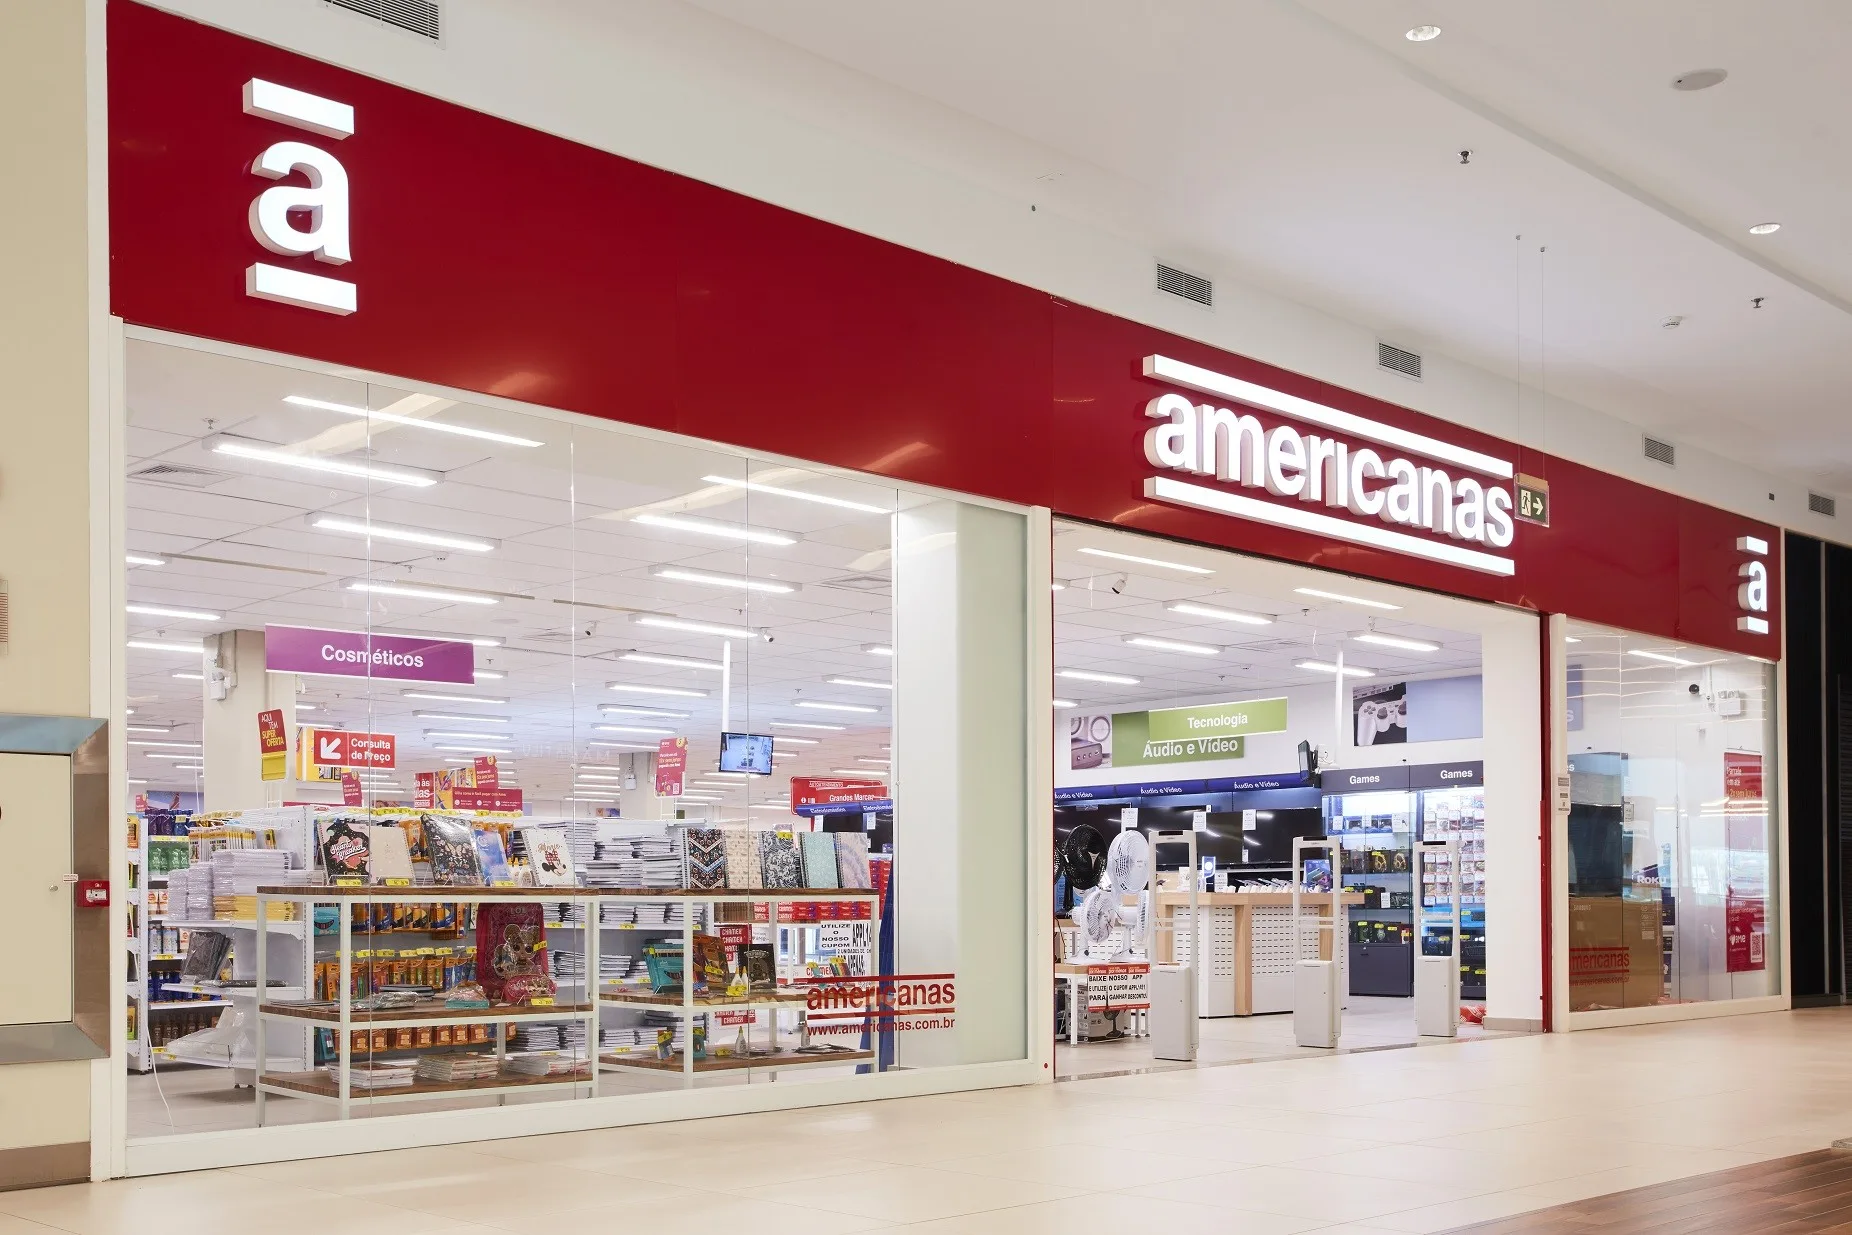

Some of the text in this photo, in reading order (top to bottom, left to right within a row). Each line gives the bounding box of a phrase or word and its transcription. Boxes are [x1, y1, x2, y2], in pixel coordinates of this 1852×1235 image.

[249, 141, 352, 266] a
[1144, 392, 1514, 549] americanas
[1738, 561, 1768, 612] a
[321, 644, 424, 668] Cosméticos
[1187, 713, 1249, 729] Tecnologia
[262, 730, 276, 740] SUPER
[266, 737, 285, 748] OFERTA
[351, 738, 391, 750] Consulta
[1143, 738, 1239, 758] Áudio e Vídeo
[351, 751, 391, 764] de Preço
[1349, 774, 1380, 785] Games
[1440, 769, 1474, 780] Games
[1140, 787, 1158, 795] Áudio
[1234, 781, 1254, 789] Áudio
[829, 794, 853, 802] Grandes
[1077, 791, 1094, 799] Vídeo
[1569, 952, 1630, 971] mericanas
[807, 983, 955, 1010] americanas
[807, 1016, 956, 1037] www.americanas.com.br
